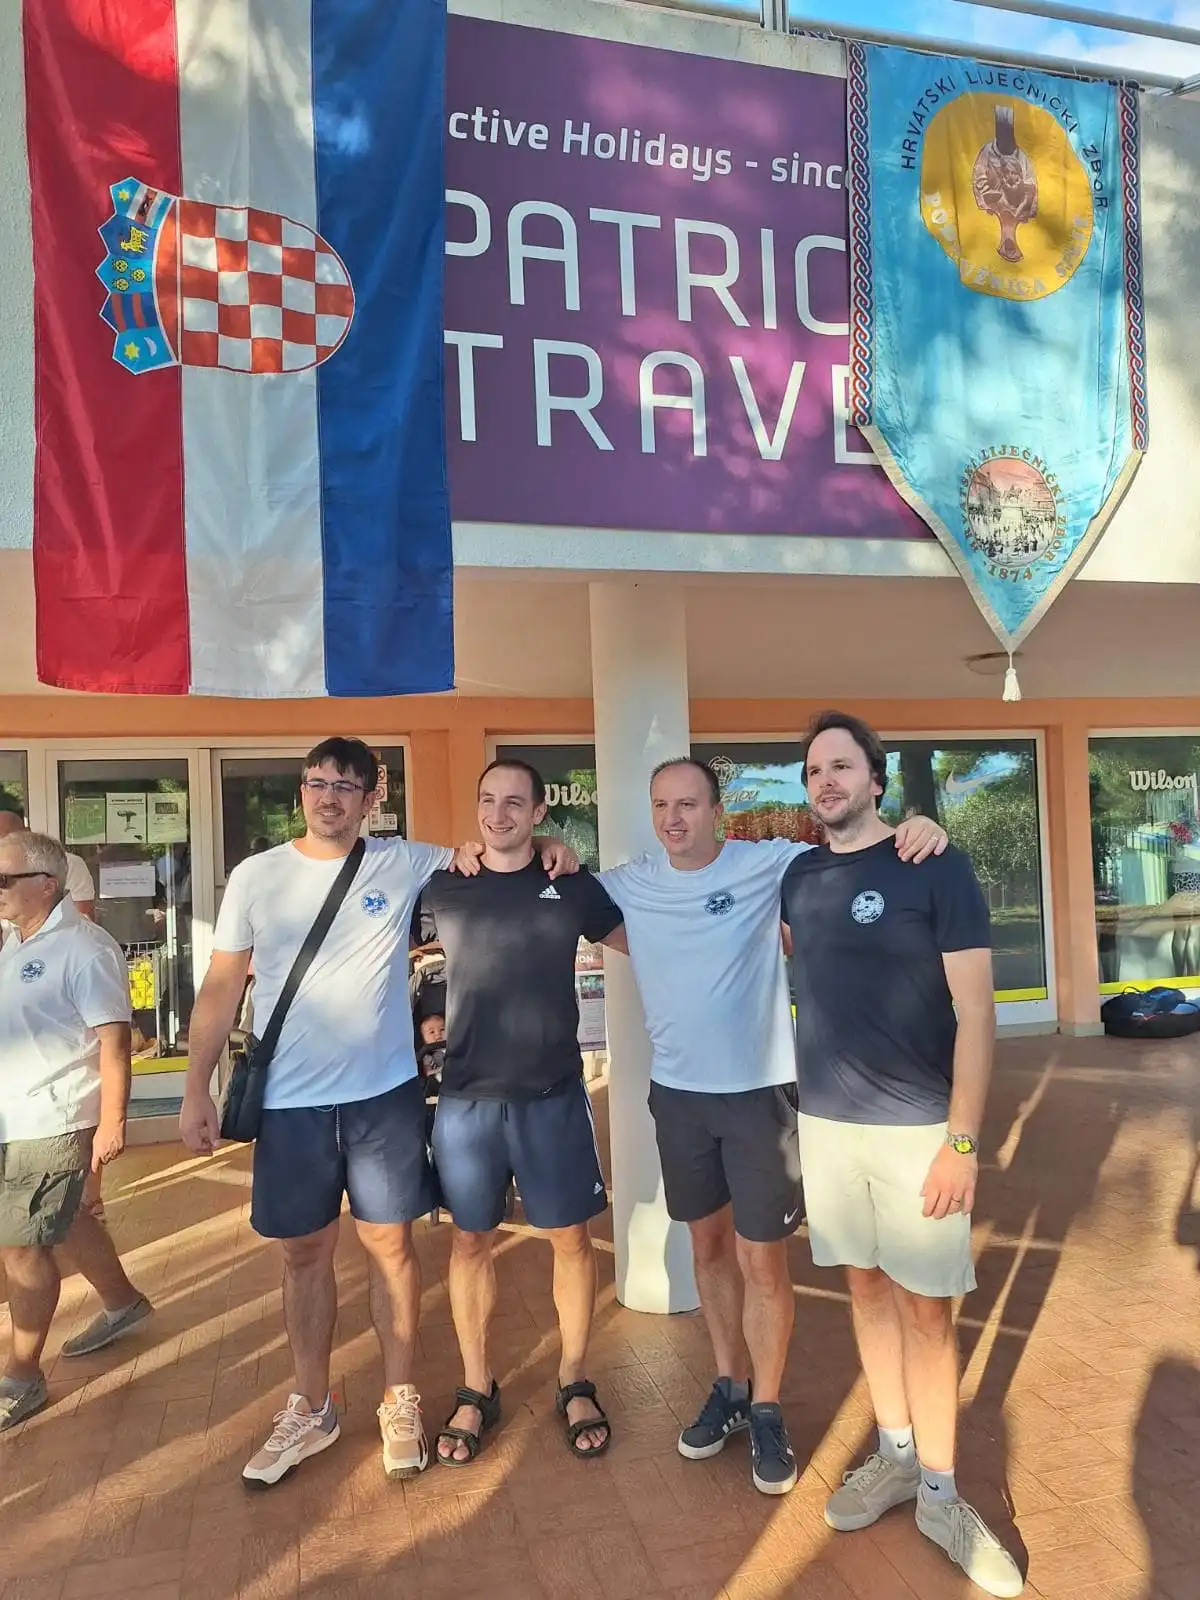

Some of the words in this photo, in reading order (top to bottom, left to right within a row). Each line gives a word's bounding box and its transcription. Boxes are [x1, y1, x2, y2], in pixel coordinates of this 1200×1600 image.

[448, 106, 549, 150] ctive
[562, 119, 732, 182] Holidays
[771, 151, 849, 190] sinc
[900, 75, 956, 170] HRVATSKI
[1082, 143, 1109, 209] ZBOR
[444, 189, 849, 336] PATRIC
[443, 329, 882, 465] TRAVE
[1128, 769, 1197, 790] Wilson
